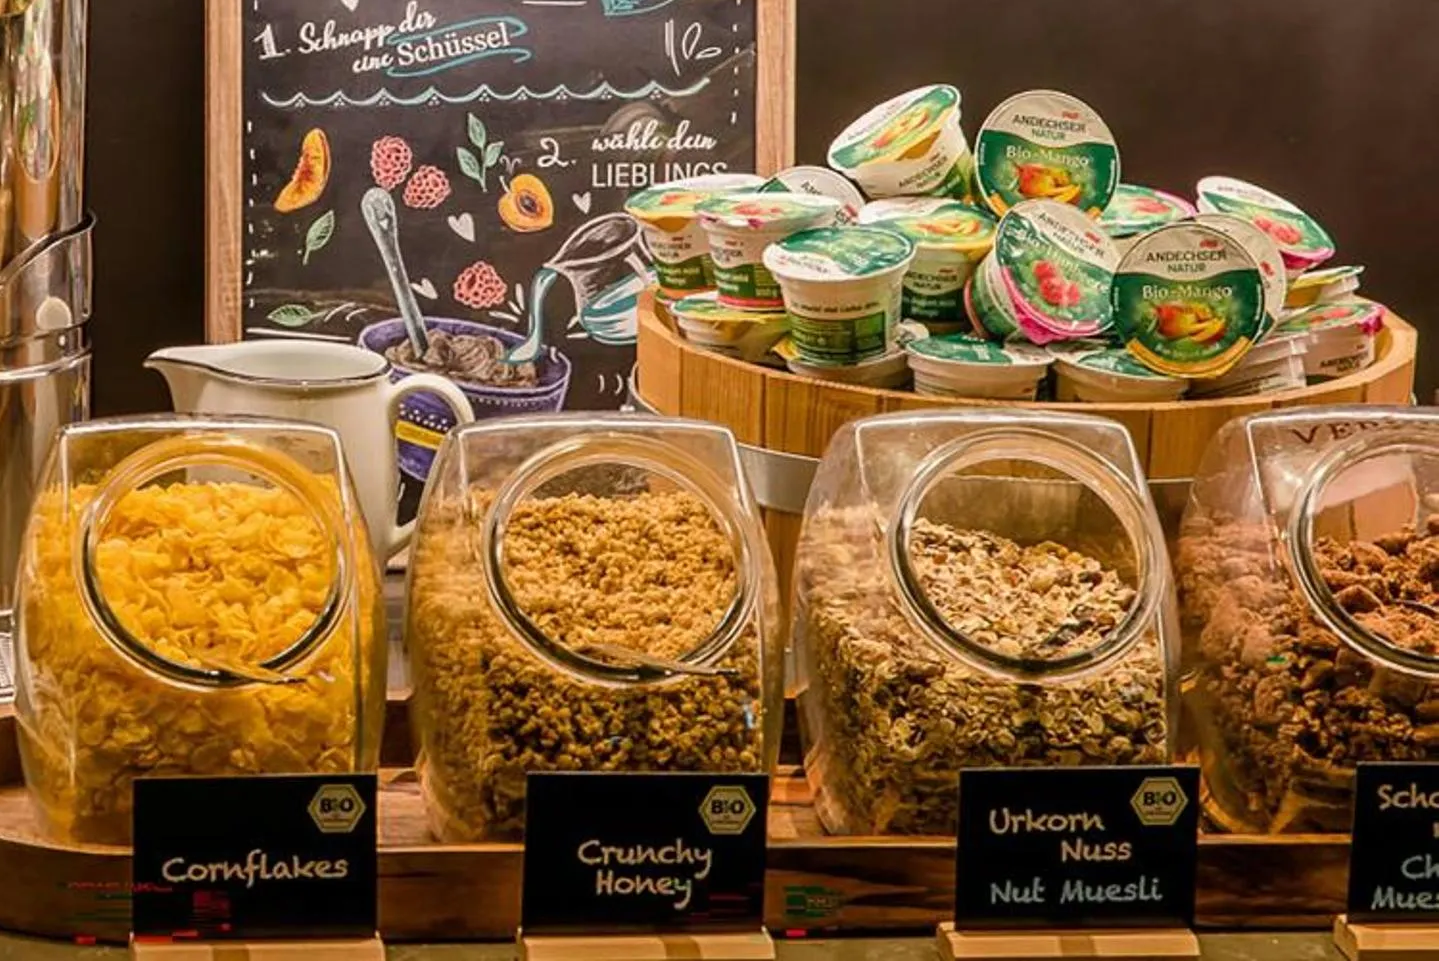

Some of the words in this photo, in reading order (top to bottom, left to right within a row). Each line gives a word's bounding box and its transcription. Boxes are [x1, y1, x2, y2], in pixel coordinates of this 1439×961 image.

[254, 23, 291, 60] 1.
[297, 19, 396, 53] Schnapp
[398, 0, 436, 33] der
[352, 54, 395, 74] eine
[396, 22, 511, 66] Schüssel
[1012, 114, 1086, 132] ANDECHSER
[1031, 127, 1066, 141] NATUR
[537, 137, 577, 168] 2.
[592, 120, 663, 152] wähle
[665, 119, 717, 151] dein
[1146, 250, 1227, 263] ANDECHSER
[1167, 262, 1207, 274] NATUR
[1142, 285, 1233, 301] Bio-Mango
[319, 797, 354, 813] BIO
[711, 799, 745, 815] BIO
[1143, 790, 1177, 807] BIO
[989, 807, 1106, 835] Urkorn
[578, 839, 713, 880] Crunchy
[1061, 837, 1133, 863] Nuss
[161, 849, 349, 889] Cornflakes
[596, 869, 692, 910] Honey
[990, 876, 1046, 905] Nut
[1060, 875, 1164, 905] Muesli
[1371, 885, 1439, 910] Mue
